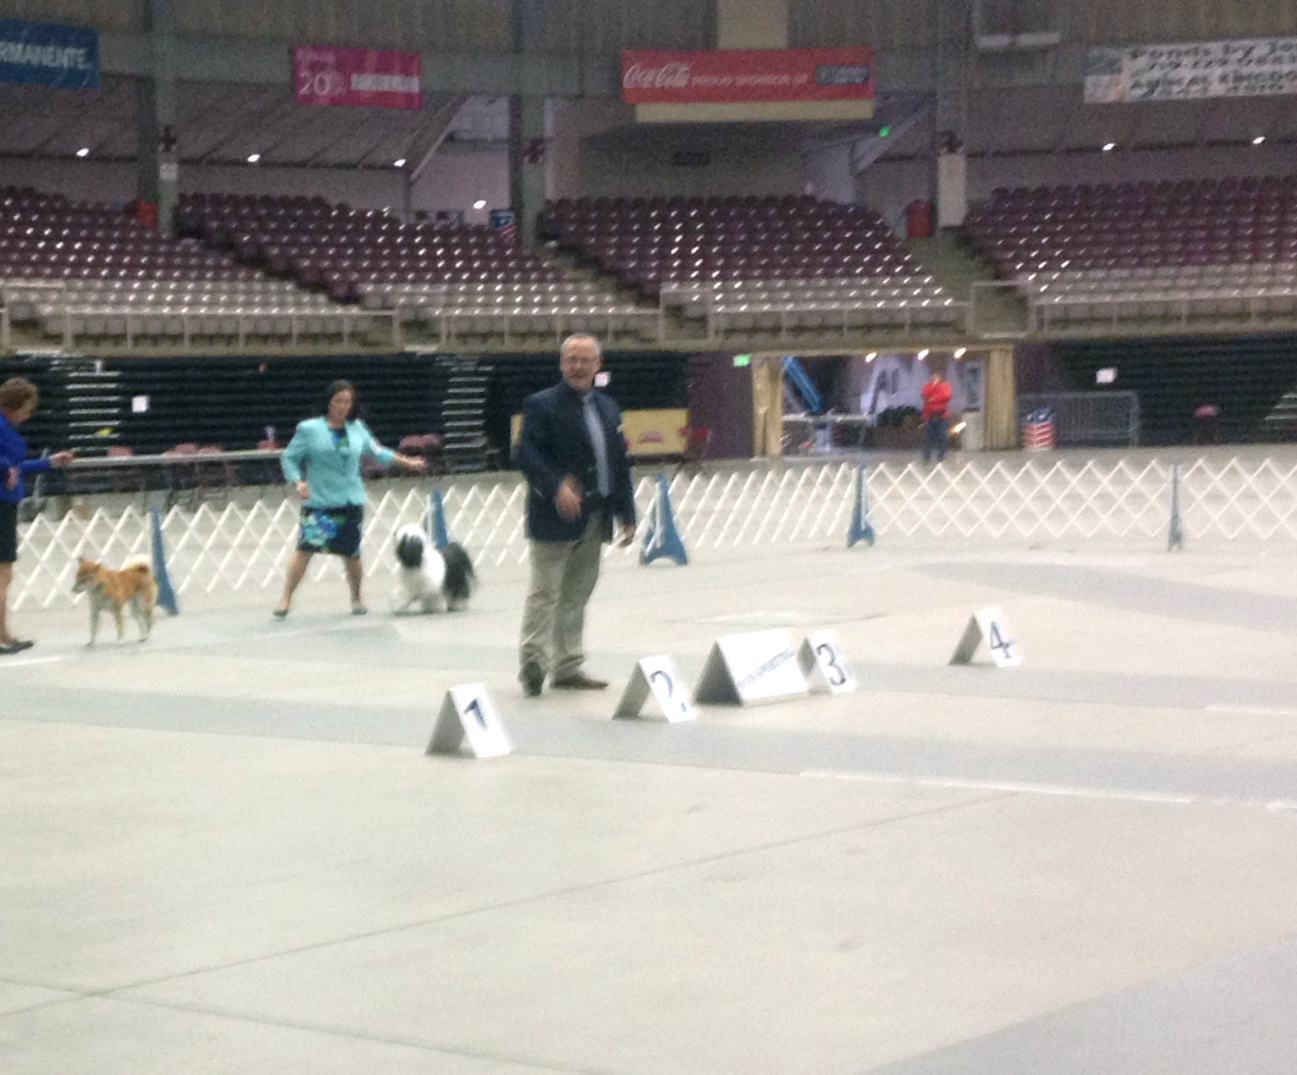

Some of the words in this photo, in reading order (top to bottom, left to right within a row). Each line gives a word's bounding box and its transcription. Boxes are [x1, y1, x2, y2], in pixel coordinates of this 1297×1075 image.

[989, 620, 1016, 660] 4
[815, 643, 846, 686] 3
[649, 669, 688, 714] 2
[463, 697, 489, 732] 1
